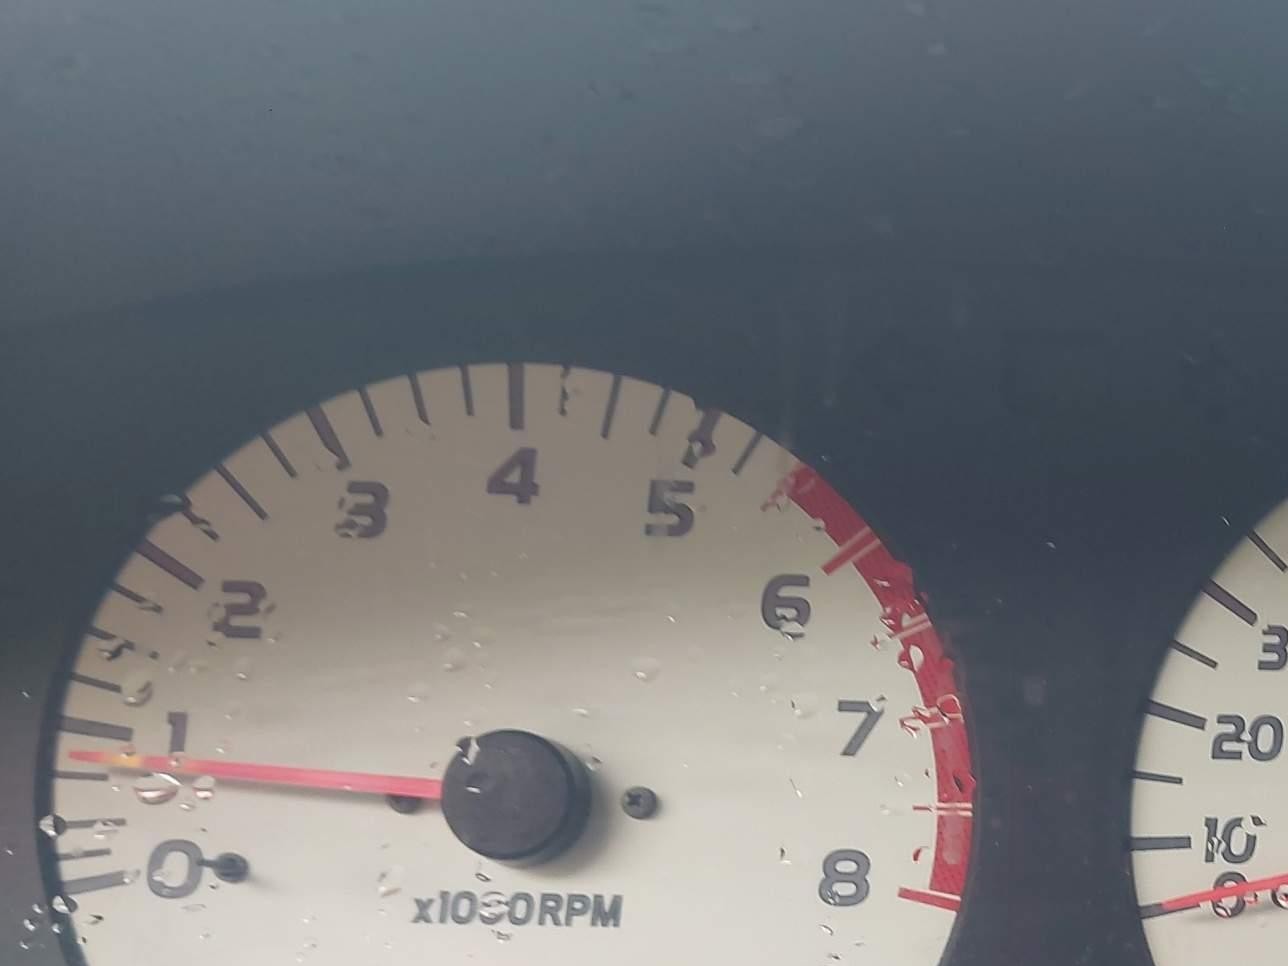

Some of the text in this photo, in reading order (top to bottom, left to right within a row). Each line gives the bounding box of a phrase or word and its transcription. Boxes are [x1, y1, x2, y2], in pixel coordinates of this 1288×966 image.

[487, 447, 540, 505] 4
[336, 481, 389, 538] 3
[644, 480, 695, 537] 5
[212, 580, 267, 639] 2
[760, 574, 812, 637] 6
[167, 711, 188, 754] 1
[837, 698, 887, 756] 7
[1211, 714, 1284, 761] 20
[146, 839, 203, 898] 0
[1204, 816, 1257, 864] 10
[818, 849, 871, 906] 8
[1210, 871, 1248, 918] 0
